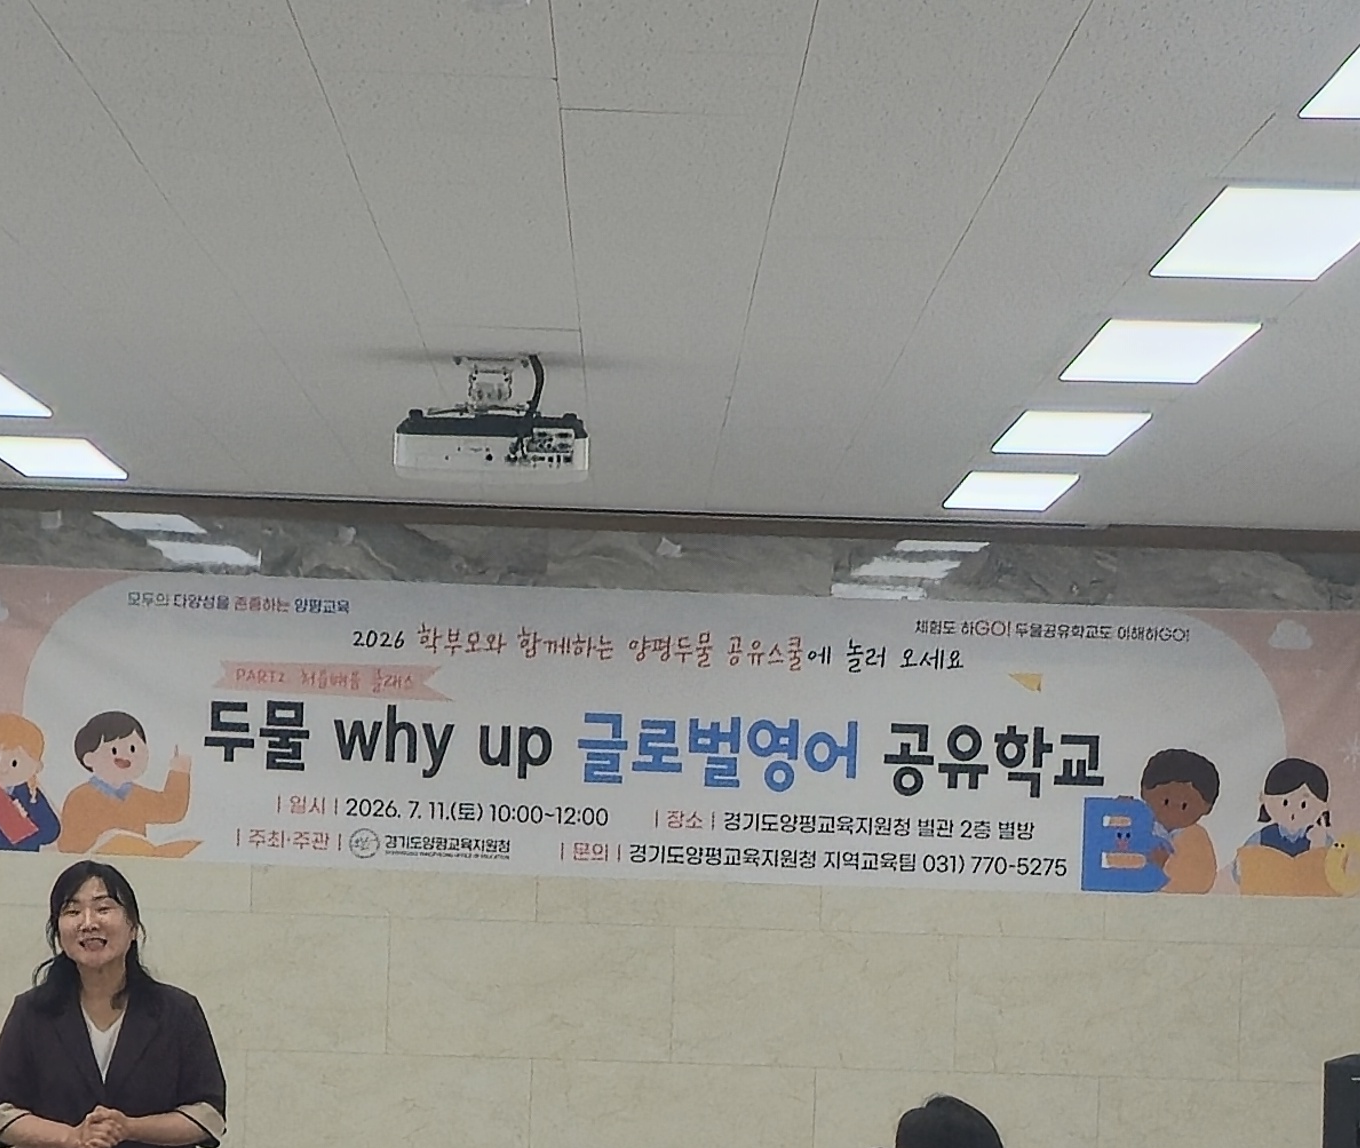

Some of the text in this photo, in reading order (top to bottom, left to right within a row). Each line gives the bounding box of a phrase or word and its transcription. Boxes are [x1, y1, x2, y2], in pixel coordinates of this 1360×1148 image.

[127, 590, 169, 607] 모두의
[173, 592, 229, 610] 다양성을
[294, 596, 350, 614] 양평교육
[915, 617, 956, 635] 체험도
[352, 622, 964, 673] 2026 학부모와 함께하는 양평두물 공유스쿨에 놀러 오세요
[204, 702, 1104, 796] 두물 why up 글로벌영어 공유학교
[289, 795, 325, 815] 일시
[344, 798, 402, 820] 2026.
[408, 800, 422, 820] 7.
[488, 803, 608, 826] 10:00~12:00
[666, 810, 703, 829] 장소
[723, 811, 910, 836] 경기도양평교육지원청
[959, 819, 992, 840] 2층
[384, 834, 510, 852] 경기도양평교육지원청
[628, 843, 816, 870] 경기도양평교육지원청
[822, 852, 916, 872] 지역교육팀
[921, 854, 965, 875] 031)
[970, 855, 1068, 877] 770-5275
